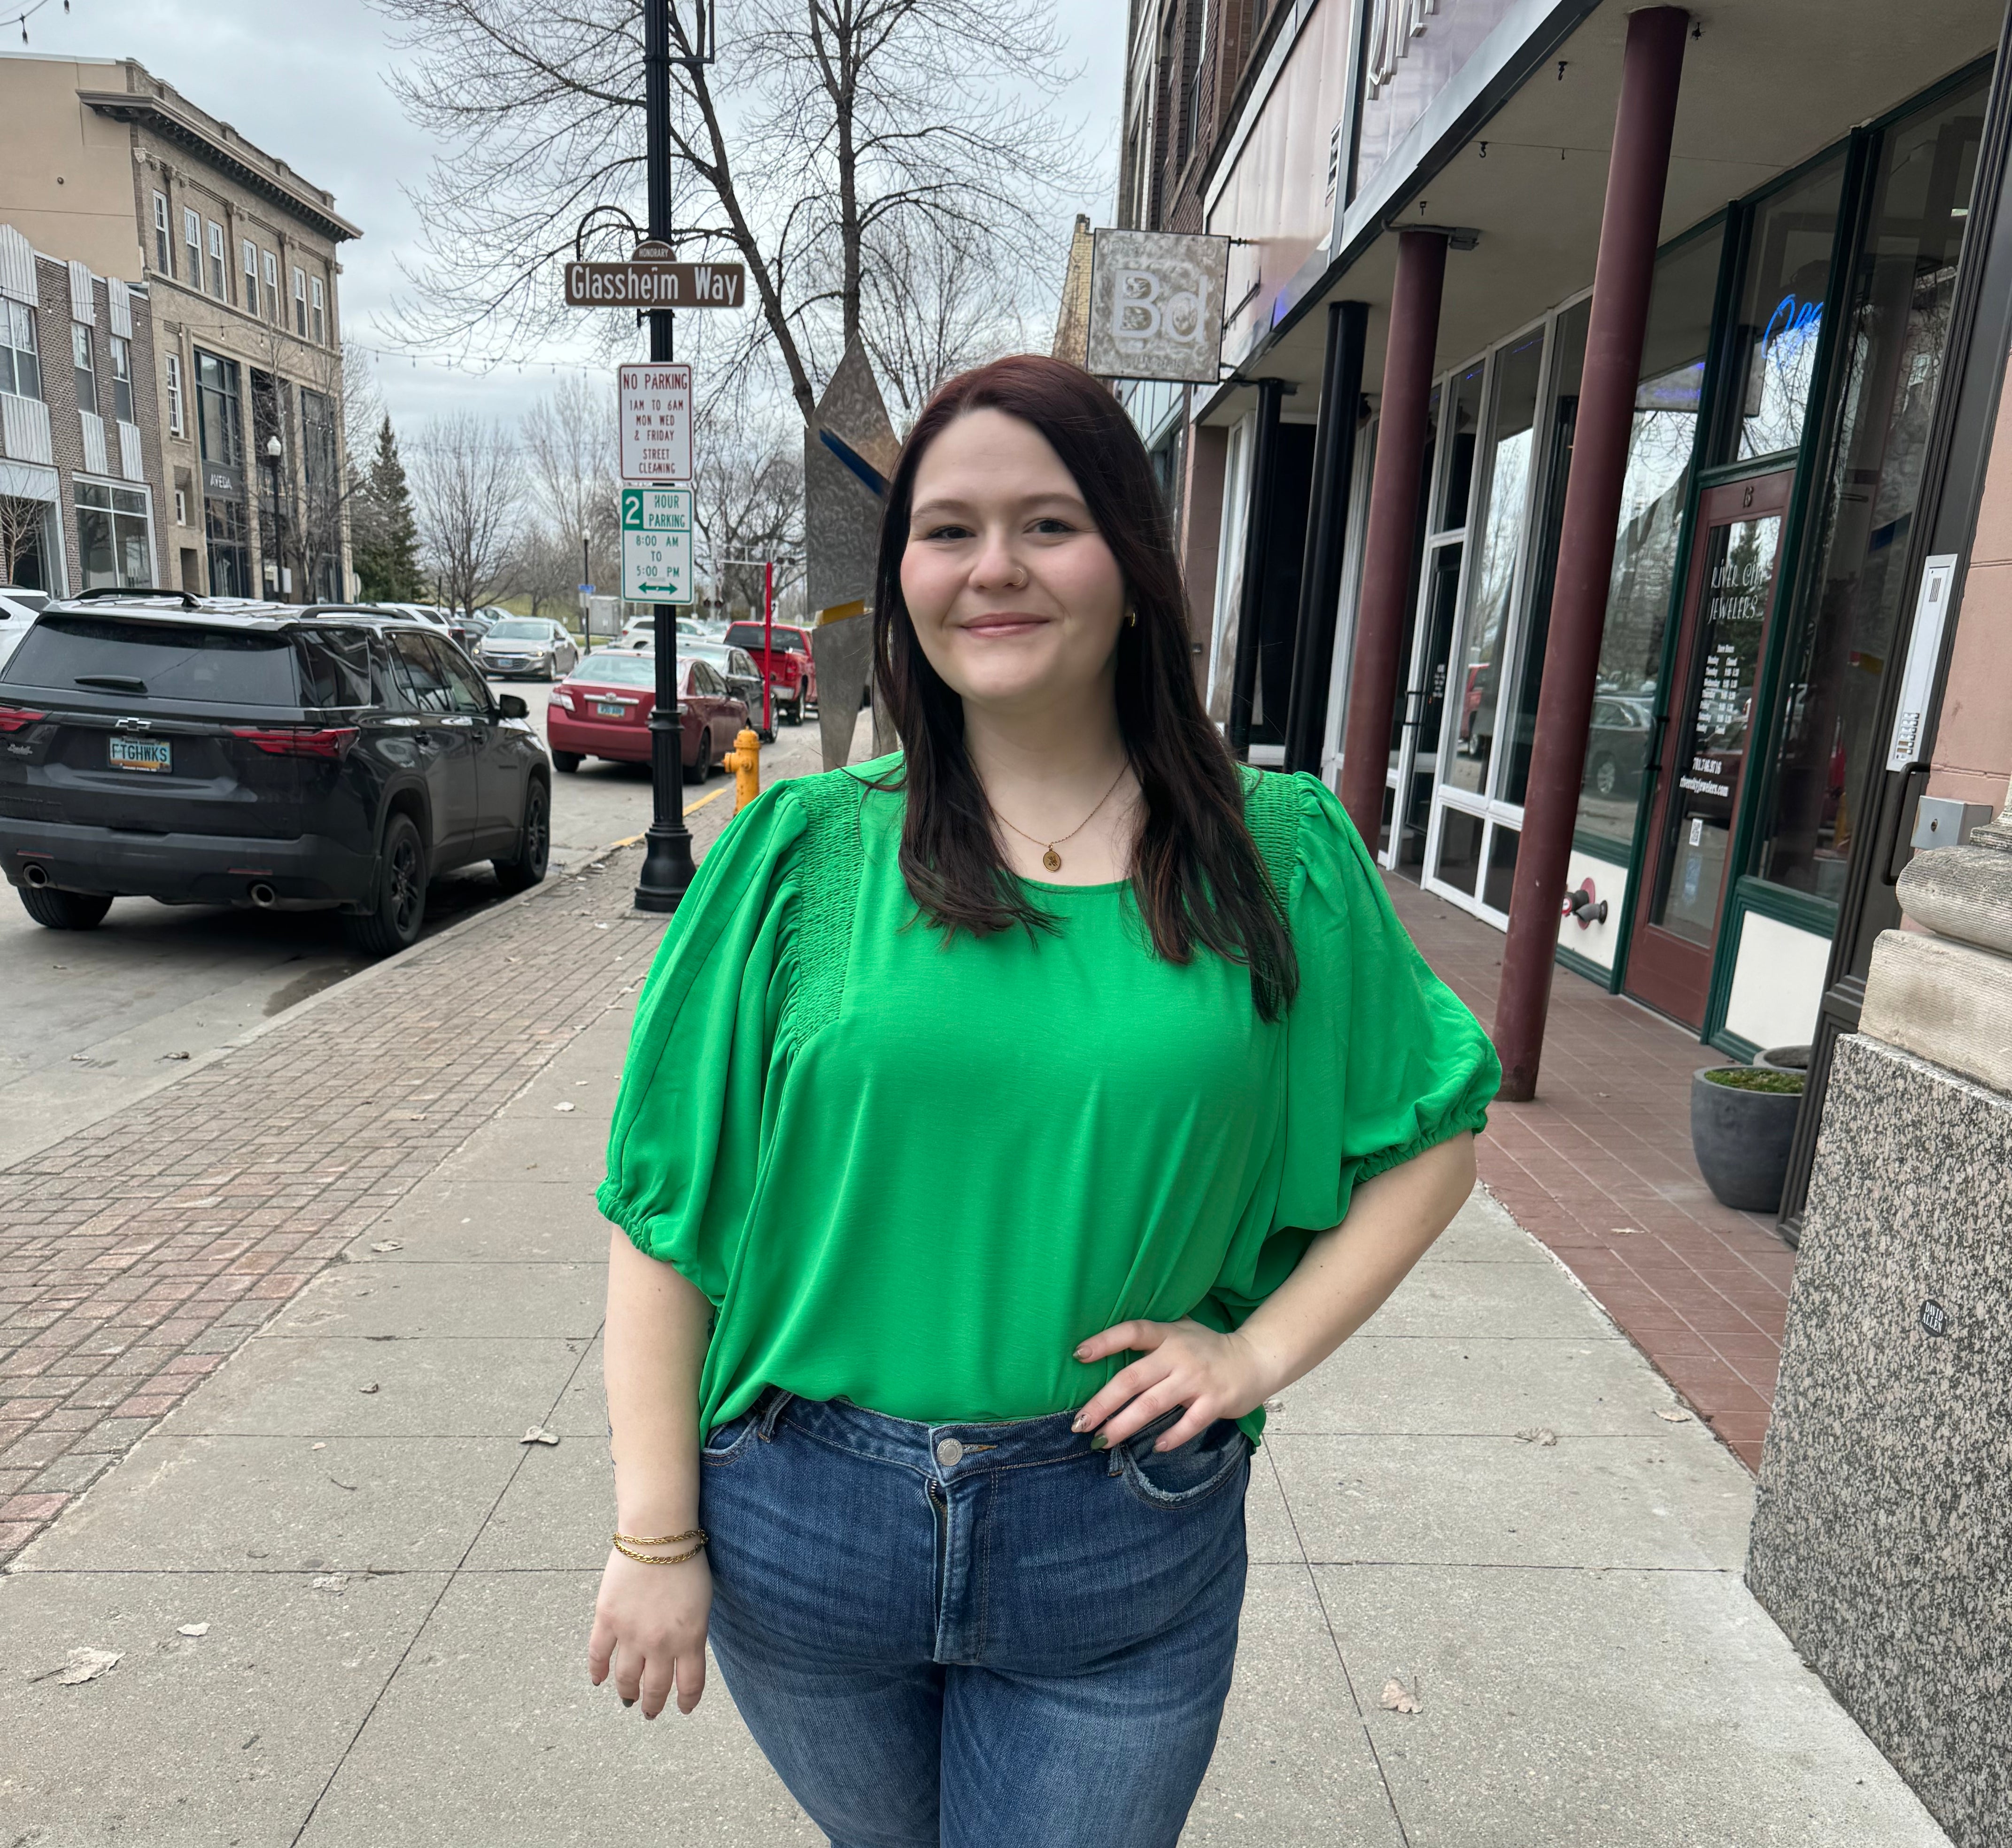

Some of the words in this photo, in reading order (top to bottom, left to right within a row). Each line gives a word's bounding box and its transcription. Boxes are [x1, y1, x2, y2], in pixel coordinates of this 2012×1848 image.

[639, 248, 668, 258] HONORARY
[572, 265, 678, 300] Glassheim
[694, 266, 737, 305] Way
[1112, 268, 1208, 344] Bd
[623, 373, 638, 390] NO
[645, 373, 688, 390] PARKING
[630, 399, 644, 411] 1AM
[652, 400, 661, 411] TO
[667, 400, 683, 411] 6AM
[636, 415, 652, 426] MON
[659, 415, 675, 426] WED
[634, 430, 640, 441] &
[647, 430, 674, 441] FRIDAY
[642, 449, 670, 460] STREET
[639, 463, 676, 474] CLEANING
[210, 473, 232, 490] AVEDA
[625, 496, 640, 524] 2
[654, 495, 679, 508] HOUR
[649, 513, 686, 528] PARKING
[636, 535, 657, 547] 8:00
[666, 536, 679, 547] AM
[651, 551, 662, 562] TO
[636, 566, 658, 577] 5:00
[667, 567, 680, 577] PM
[1707, 595, 1758, 625] JEWELERS
[112, 744, 167, 762] FTGHWKS
[1925, 1301, 1943, 1321] DAVID
[1921, 1312, 1942, 1334] ALLEN
